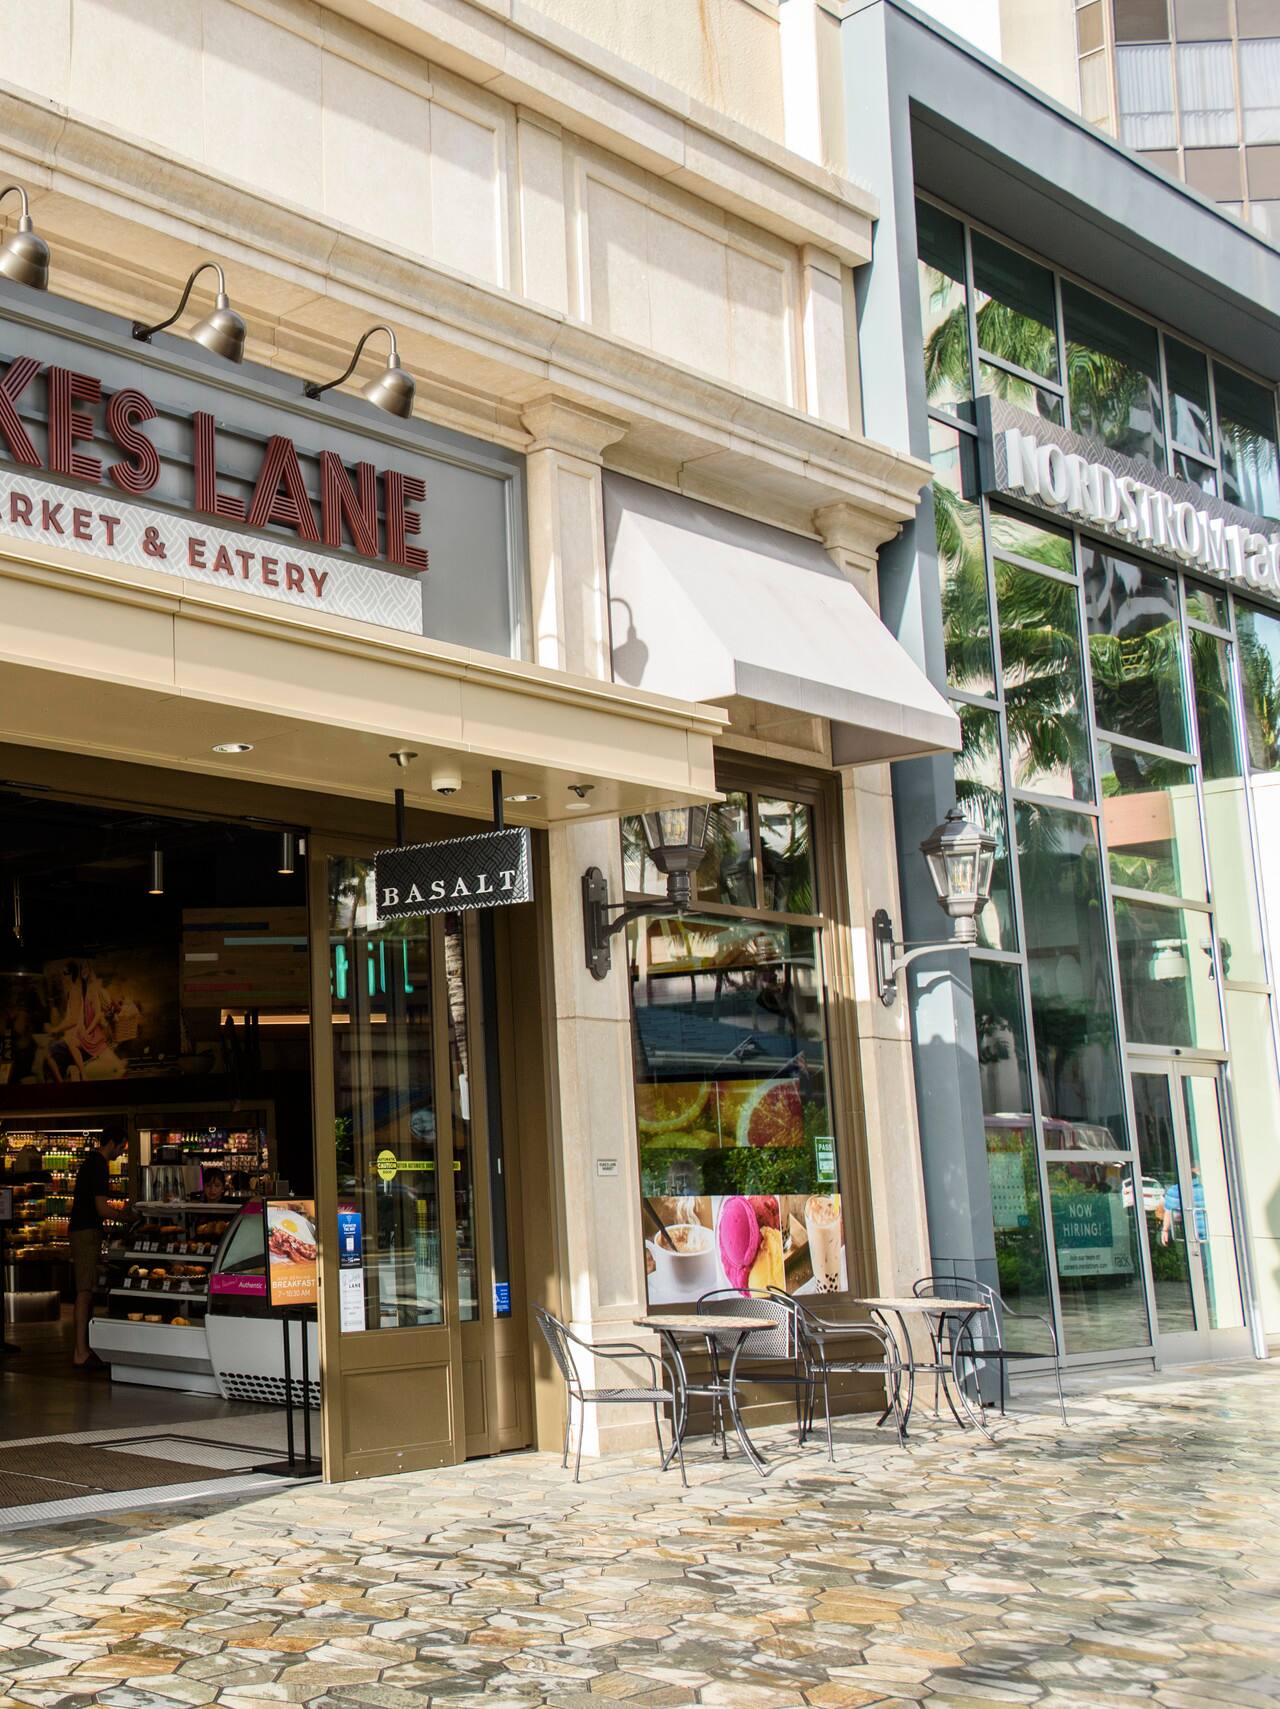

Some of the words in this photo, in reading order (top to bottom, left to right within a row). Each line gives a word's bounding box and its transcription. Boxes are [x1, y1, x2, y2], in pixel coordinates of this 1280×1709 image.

[192, 409, 430, 573] LANE
[1005, 428, 1230, 573] NORDSTROM
[142, 526, 168, 560] &
[188, 536, 329, 599] EATERY
[381, 869, 517, 908] BASALT
[818, 1143, 833, 1152] PASS
[1068, 1203, 1093, 1218] NOW
[1062, 1222, 1102, 1237] HIRING!
[238, 1281, 263, 1289] Authentic
[272, 1279, 316, 1289] BREAKFAST
[301, 1289, 311, 1297] AM
